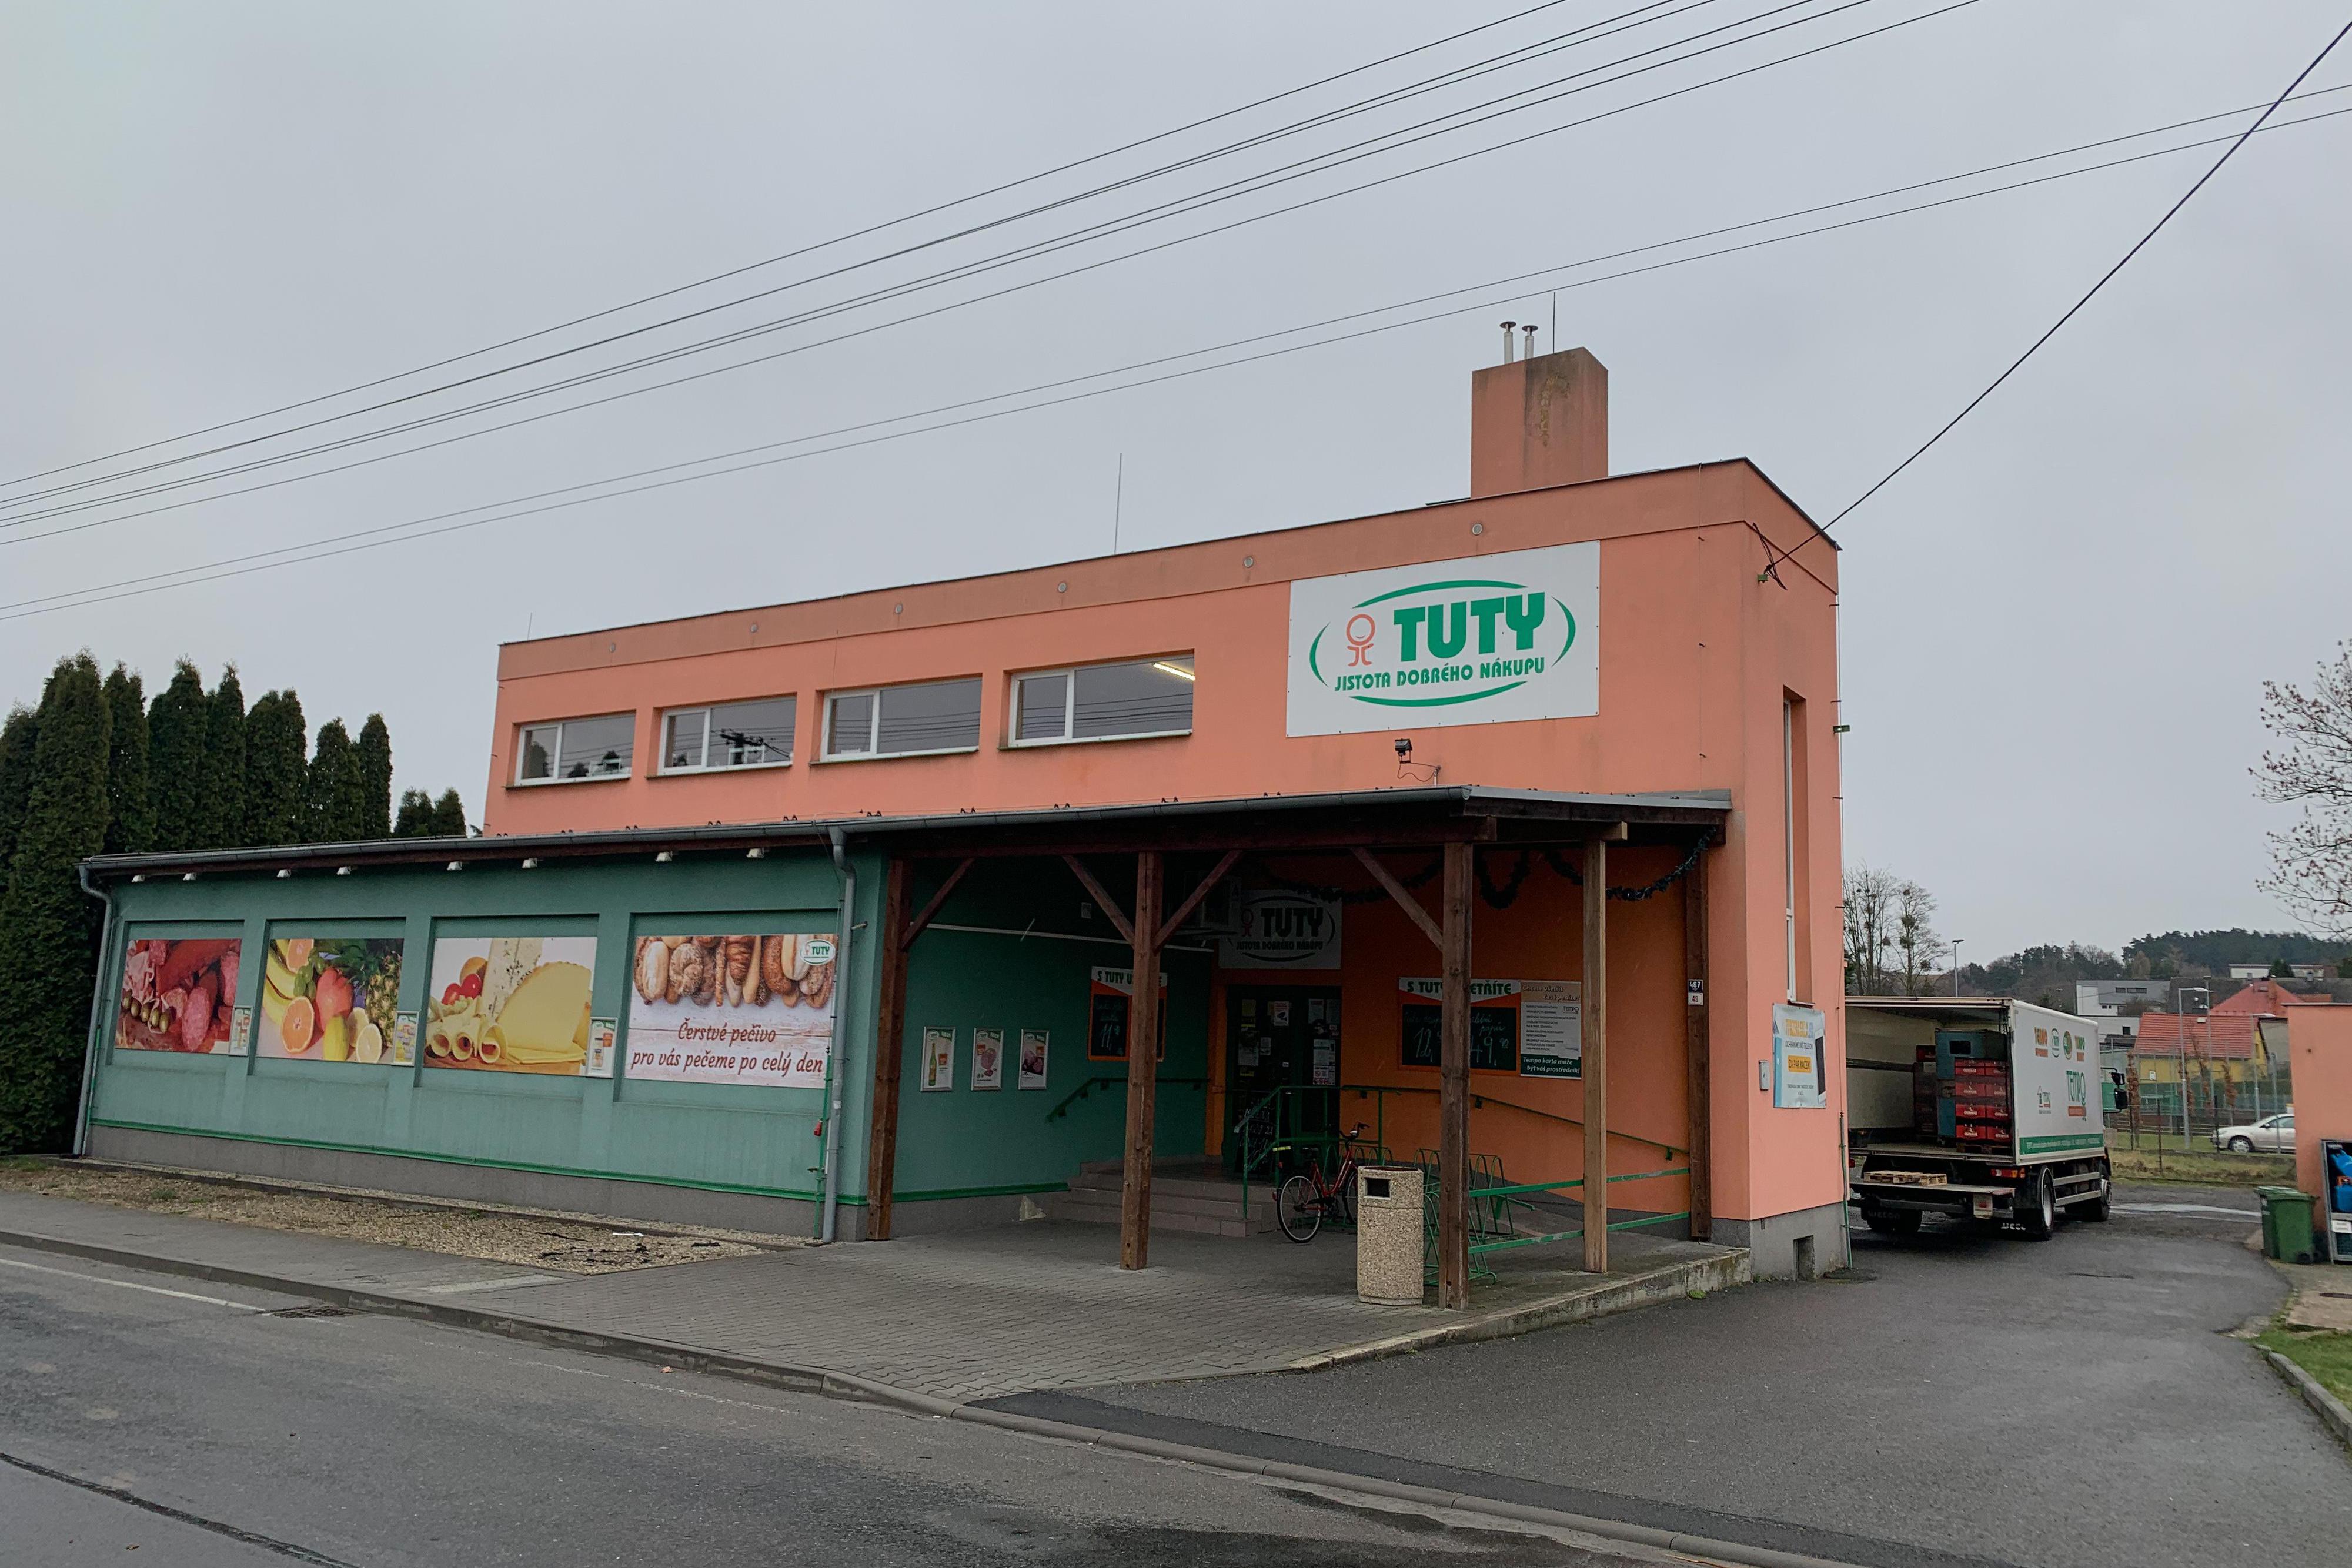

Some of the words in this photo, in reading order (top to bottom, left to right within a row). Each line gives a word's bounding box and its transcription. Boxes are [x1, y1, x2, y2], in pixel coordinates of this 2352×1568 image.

[1393, 591, 1545, 662] TUTY
[1334, 671, 1391, 691] JISTOTA
[1396, 661, 1473, 687] DOBRÉHO
[1479, 657, 1545, 679] NÁKUPU
[1261, 907, 1324, 937] TUTY
[811, 946, 830, 955] TUTY
[1097, 971, 1102, 981] S
[1105, 971, 1124, 984] TUTY
[1407, 981, 1414, 992] S
[1469, 980, 1512, 995] ETŘÍTE
[678, 1017, 727, 1041] Čerstvé
[729, 1023, 777, 1047] pečivo
[631, 1051, 654, 1070] pro
[658, 1048, 681, 1067] vás
[683, 1050, 735, 1072] pečeme
[738, 1057, 757, 1075] po
[761, 1051, 793, 1077] celý
[796, 1052, 823, 1073] den
[2066, 1070, 2086, 1103] TEMPO
